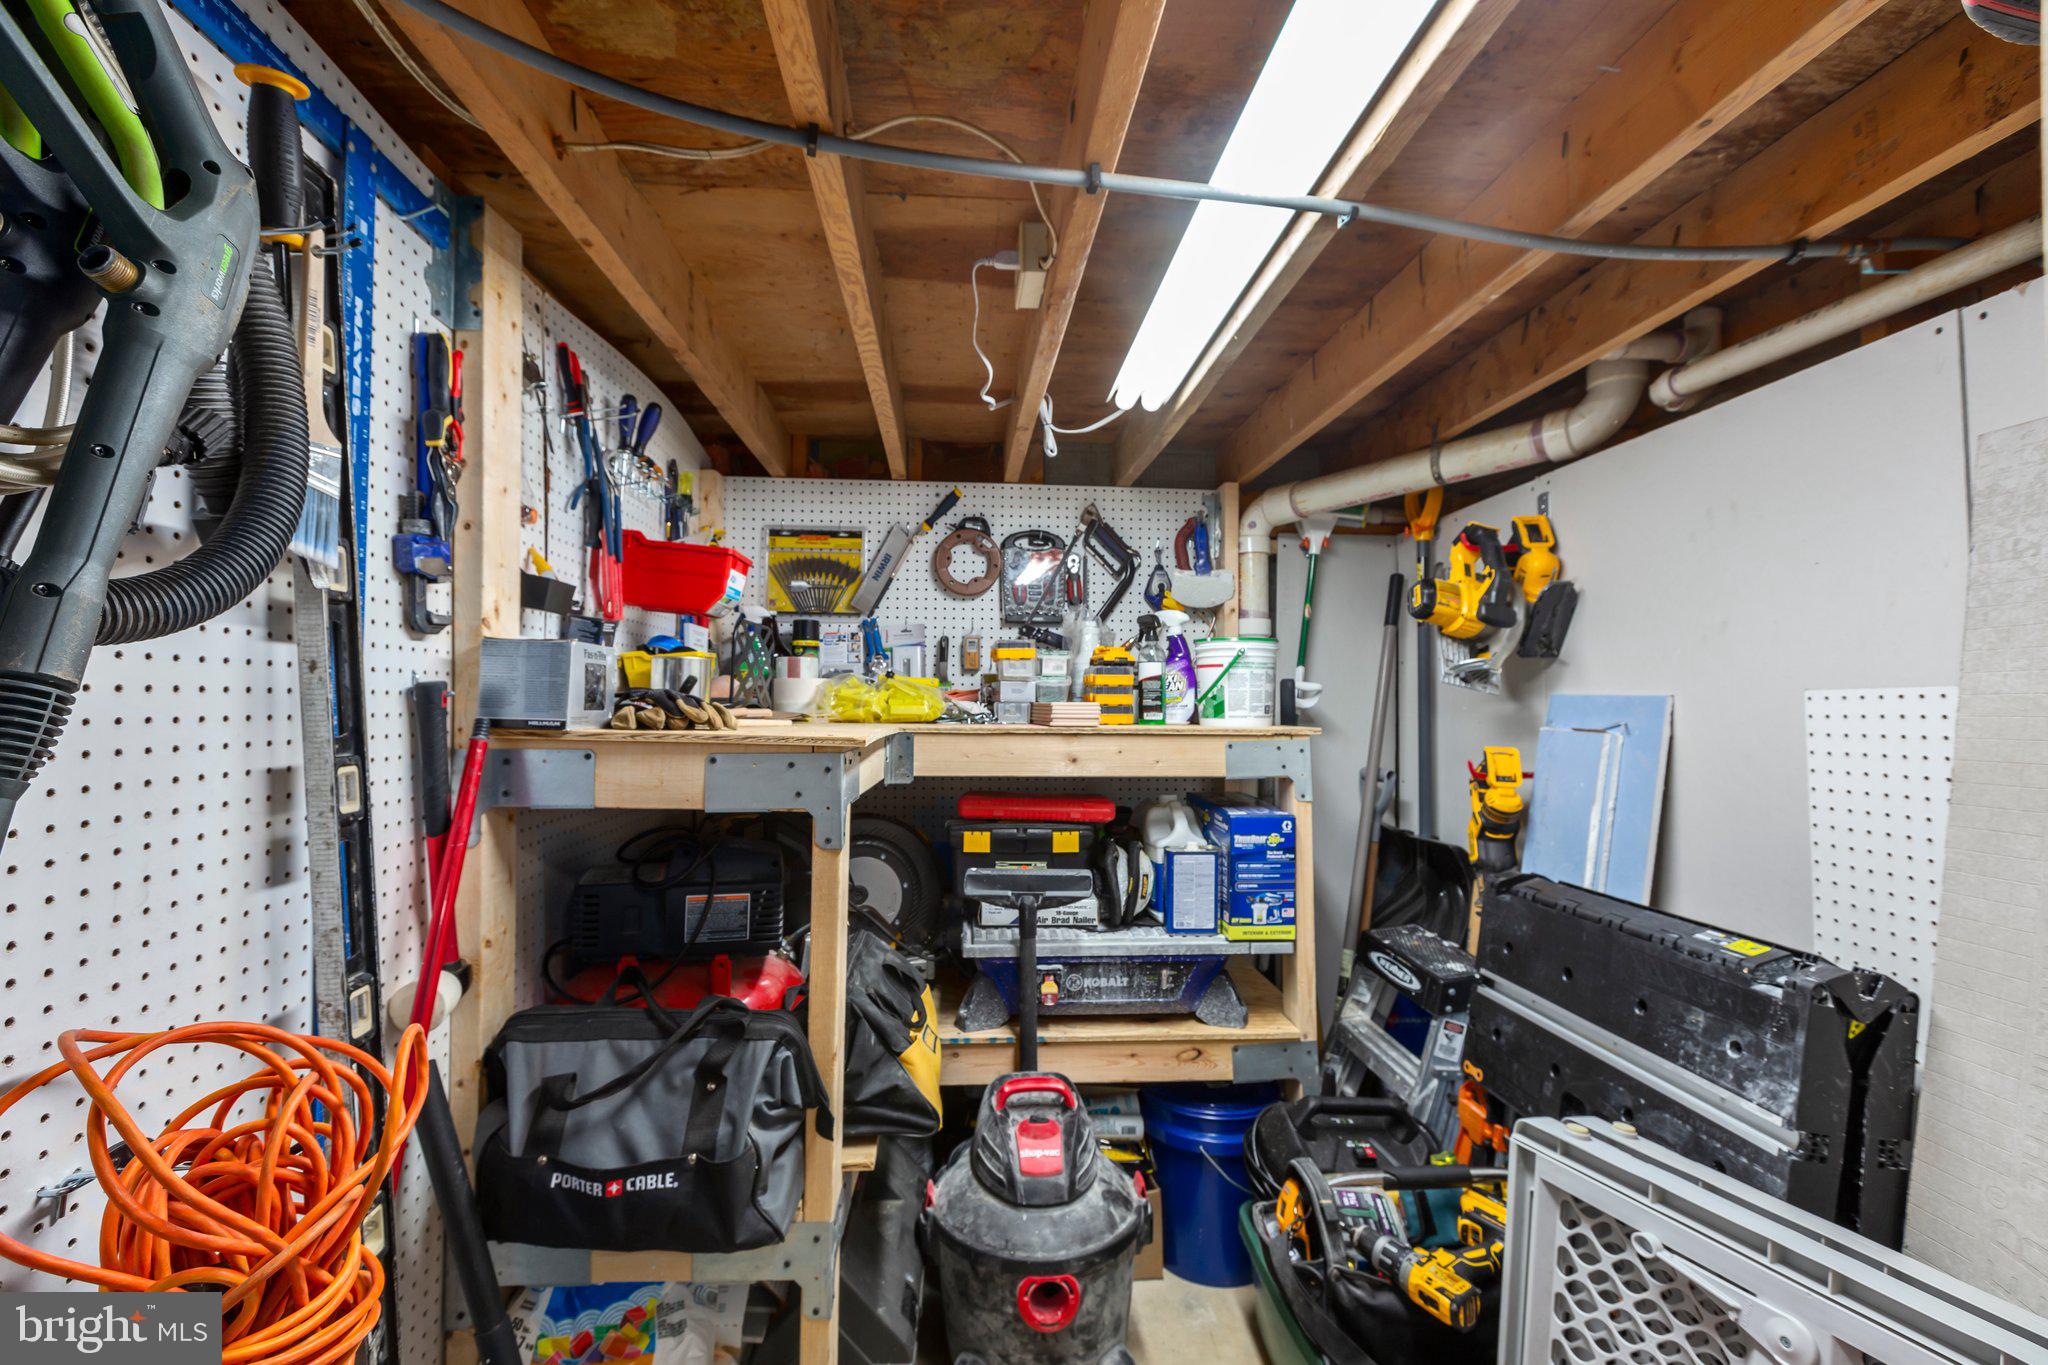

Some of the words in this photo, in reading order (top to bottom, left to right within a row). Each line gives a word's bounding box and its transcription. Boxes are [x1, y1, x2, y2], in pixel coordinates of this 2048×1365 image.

[210, 242, 233, 301] greenworks
[352, 295, 363, 416] MAYES
[872, 552, 892, 581] IRWIN
[1037, 916, 1049, 924] Air
[1051, 916, 1070, 924] Brad
[1072, 916, 1096, 924] Nailer
[1083, 975, 1129, 987] KOBALT
[550, 1172, 603, 1197] PORTER
